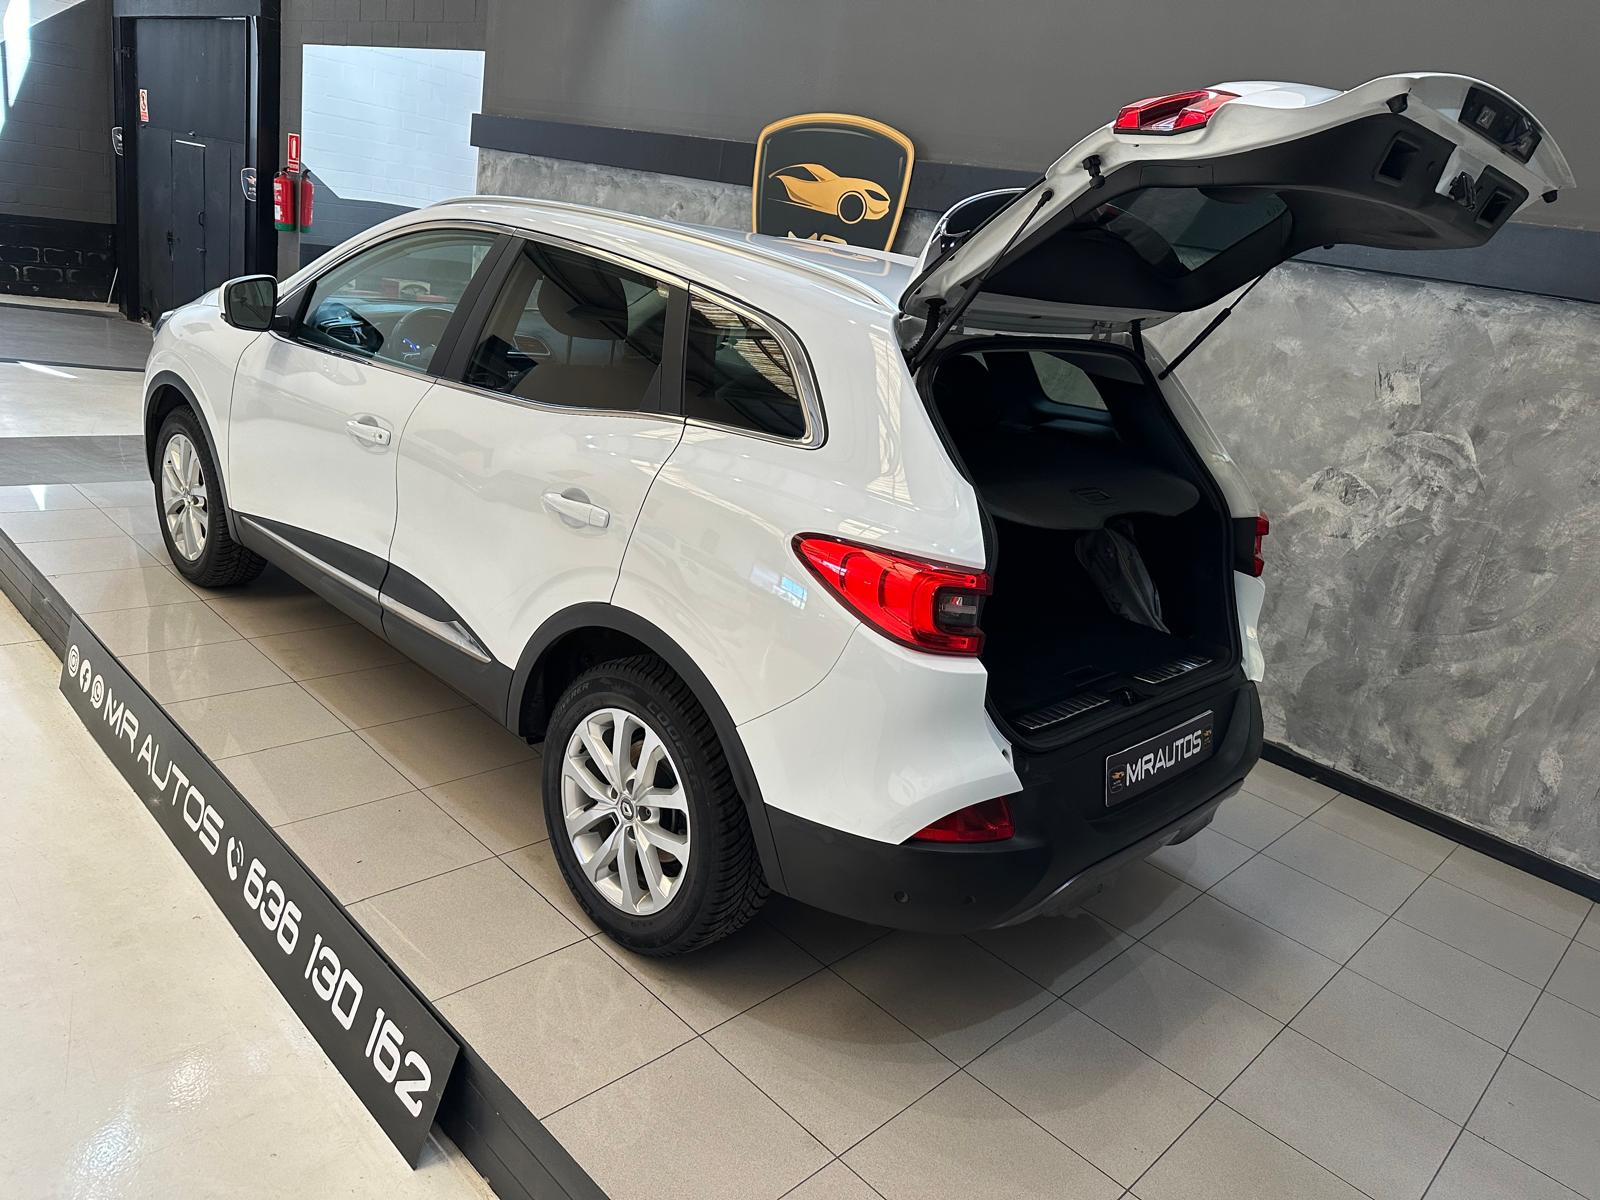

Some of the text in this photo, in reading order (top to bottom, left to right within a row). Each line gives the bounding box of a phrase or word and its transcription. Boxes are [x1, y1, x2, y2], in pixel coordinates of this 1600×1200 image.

[103, 687, 432, 1118] MR AUTOS 636 130 162
